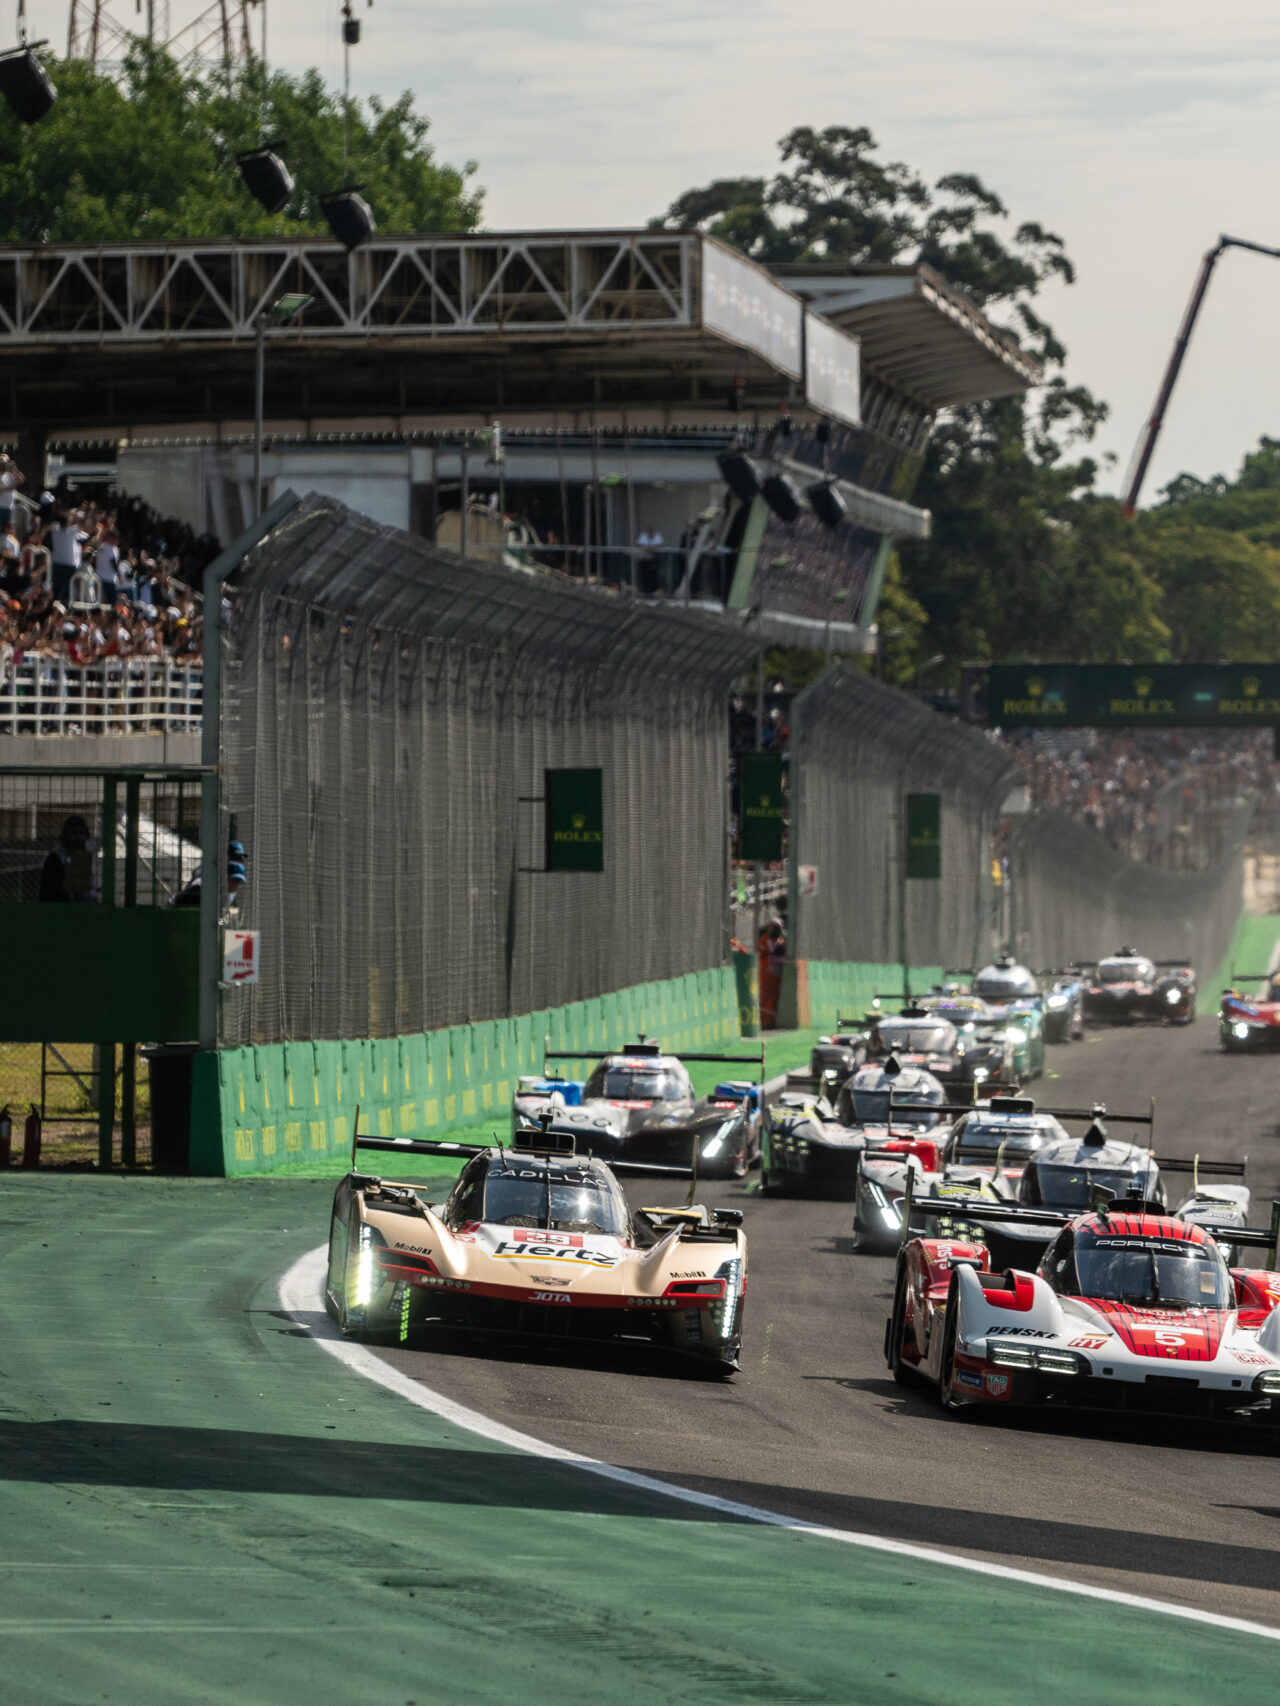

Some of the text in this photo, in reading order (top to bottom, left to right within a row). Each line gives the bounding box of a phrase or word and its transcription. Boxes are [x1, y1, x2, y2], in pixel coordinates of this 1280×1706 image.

[487, 1168, 609, 1189] CADILLAC
[494, 1241, 619, 1265] Hertz
[528, 1291, 572, 1303] JOTA
[985, 1325, 1061, 1341] PENSKE
[1155, 1330, 1186, 1347] 5
